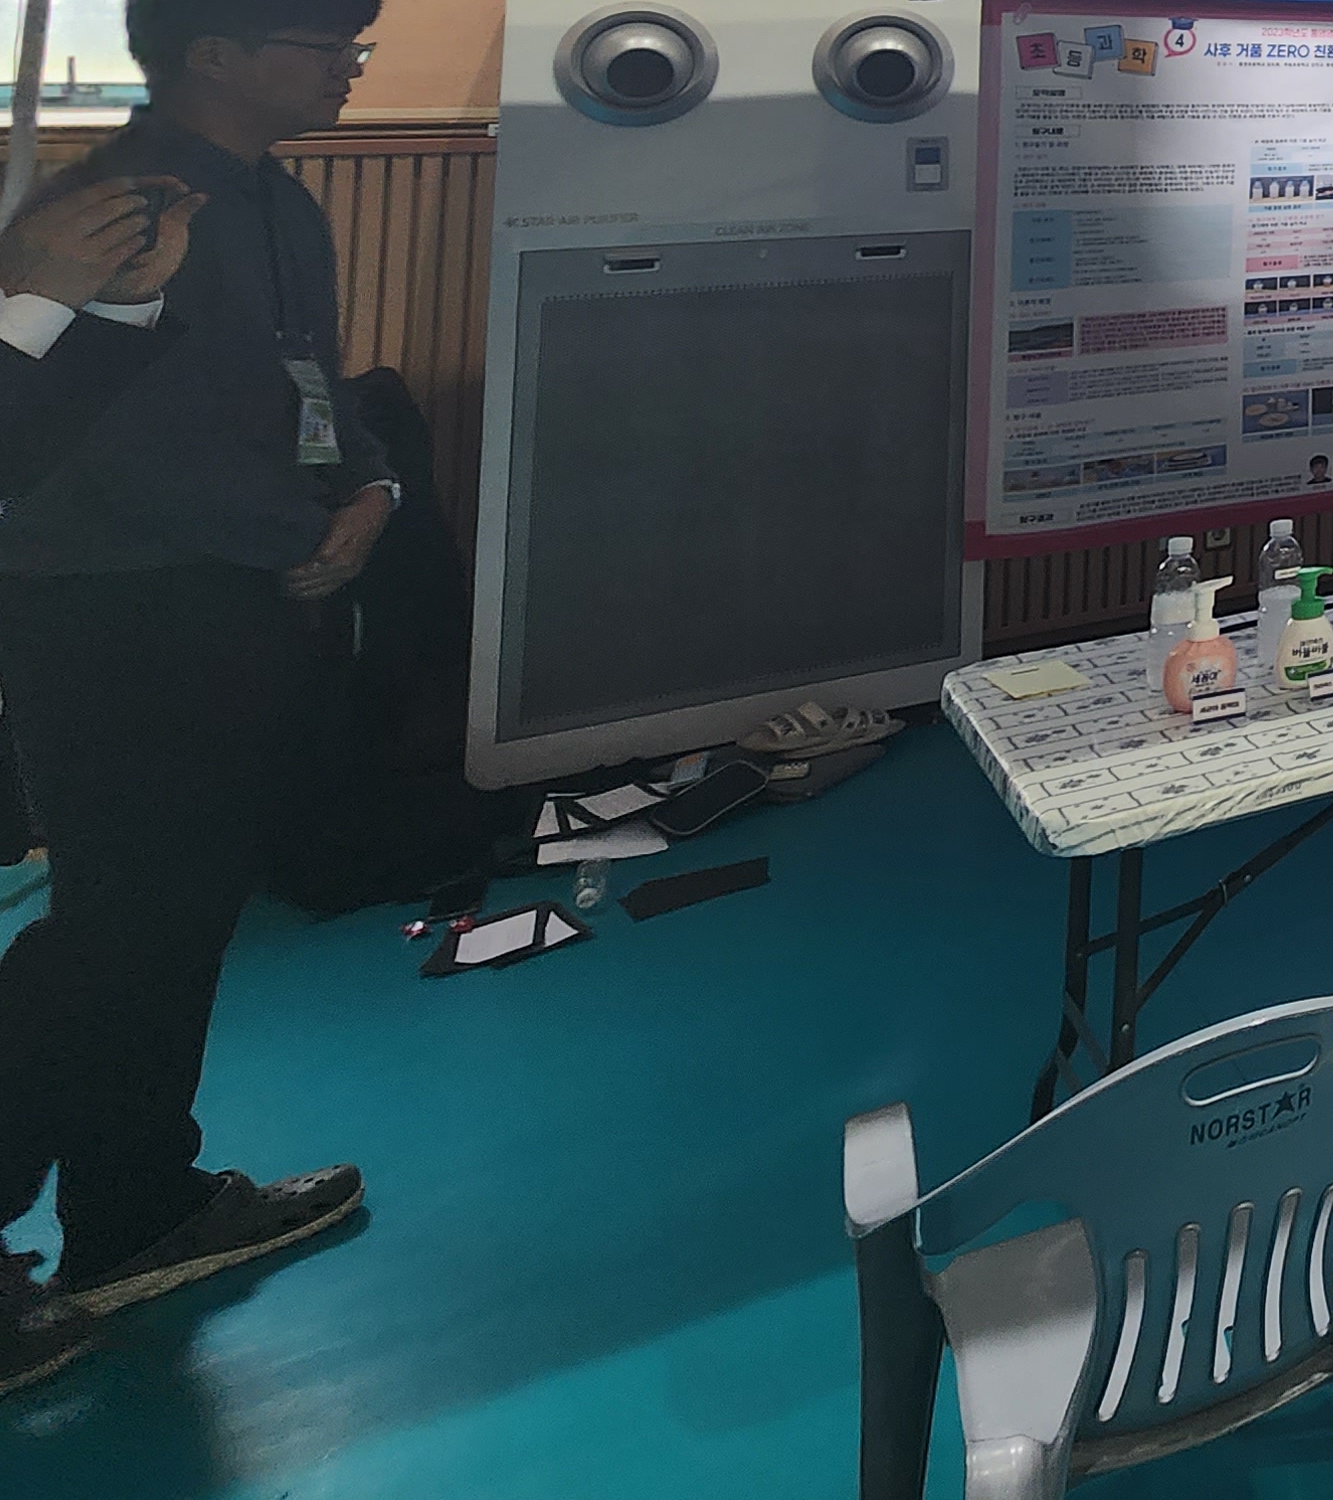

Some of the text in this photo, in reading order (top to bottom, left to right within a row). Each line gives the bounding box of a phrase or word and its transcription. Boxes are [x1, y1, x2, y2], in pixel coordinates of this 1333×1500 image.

[1174, 33, 1185, 48] 4
[1203, 42, 1232, 58] 사후
[1236, 42, 1262, 58] 거품
[1266, 44, 1310, 58] ZERO
